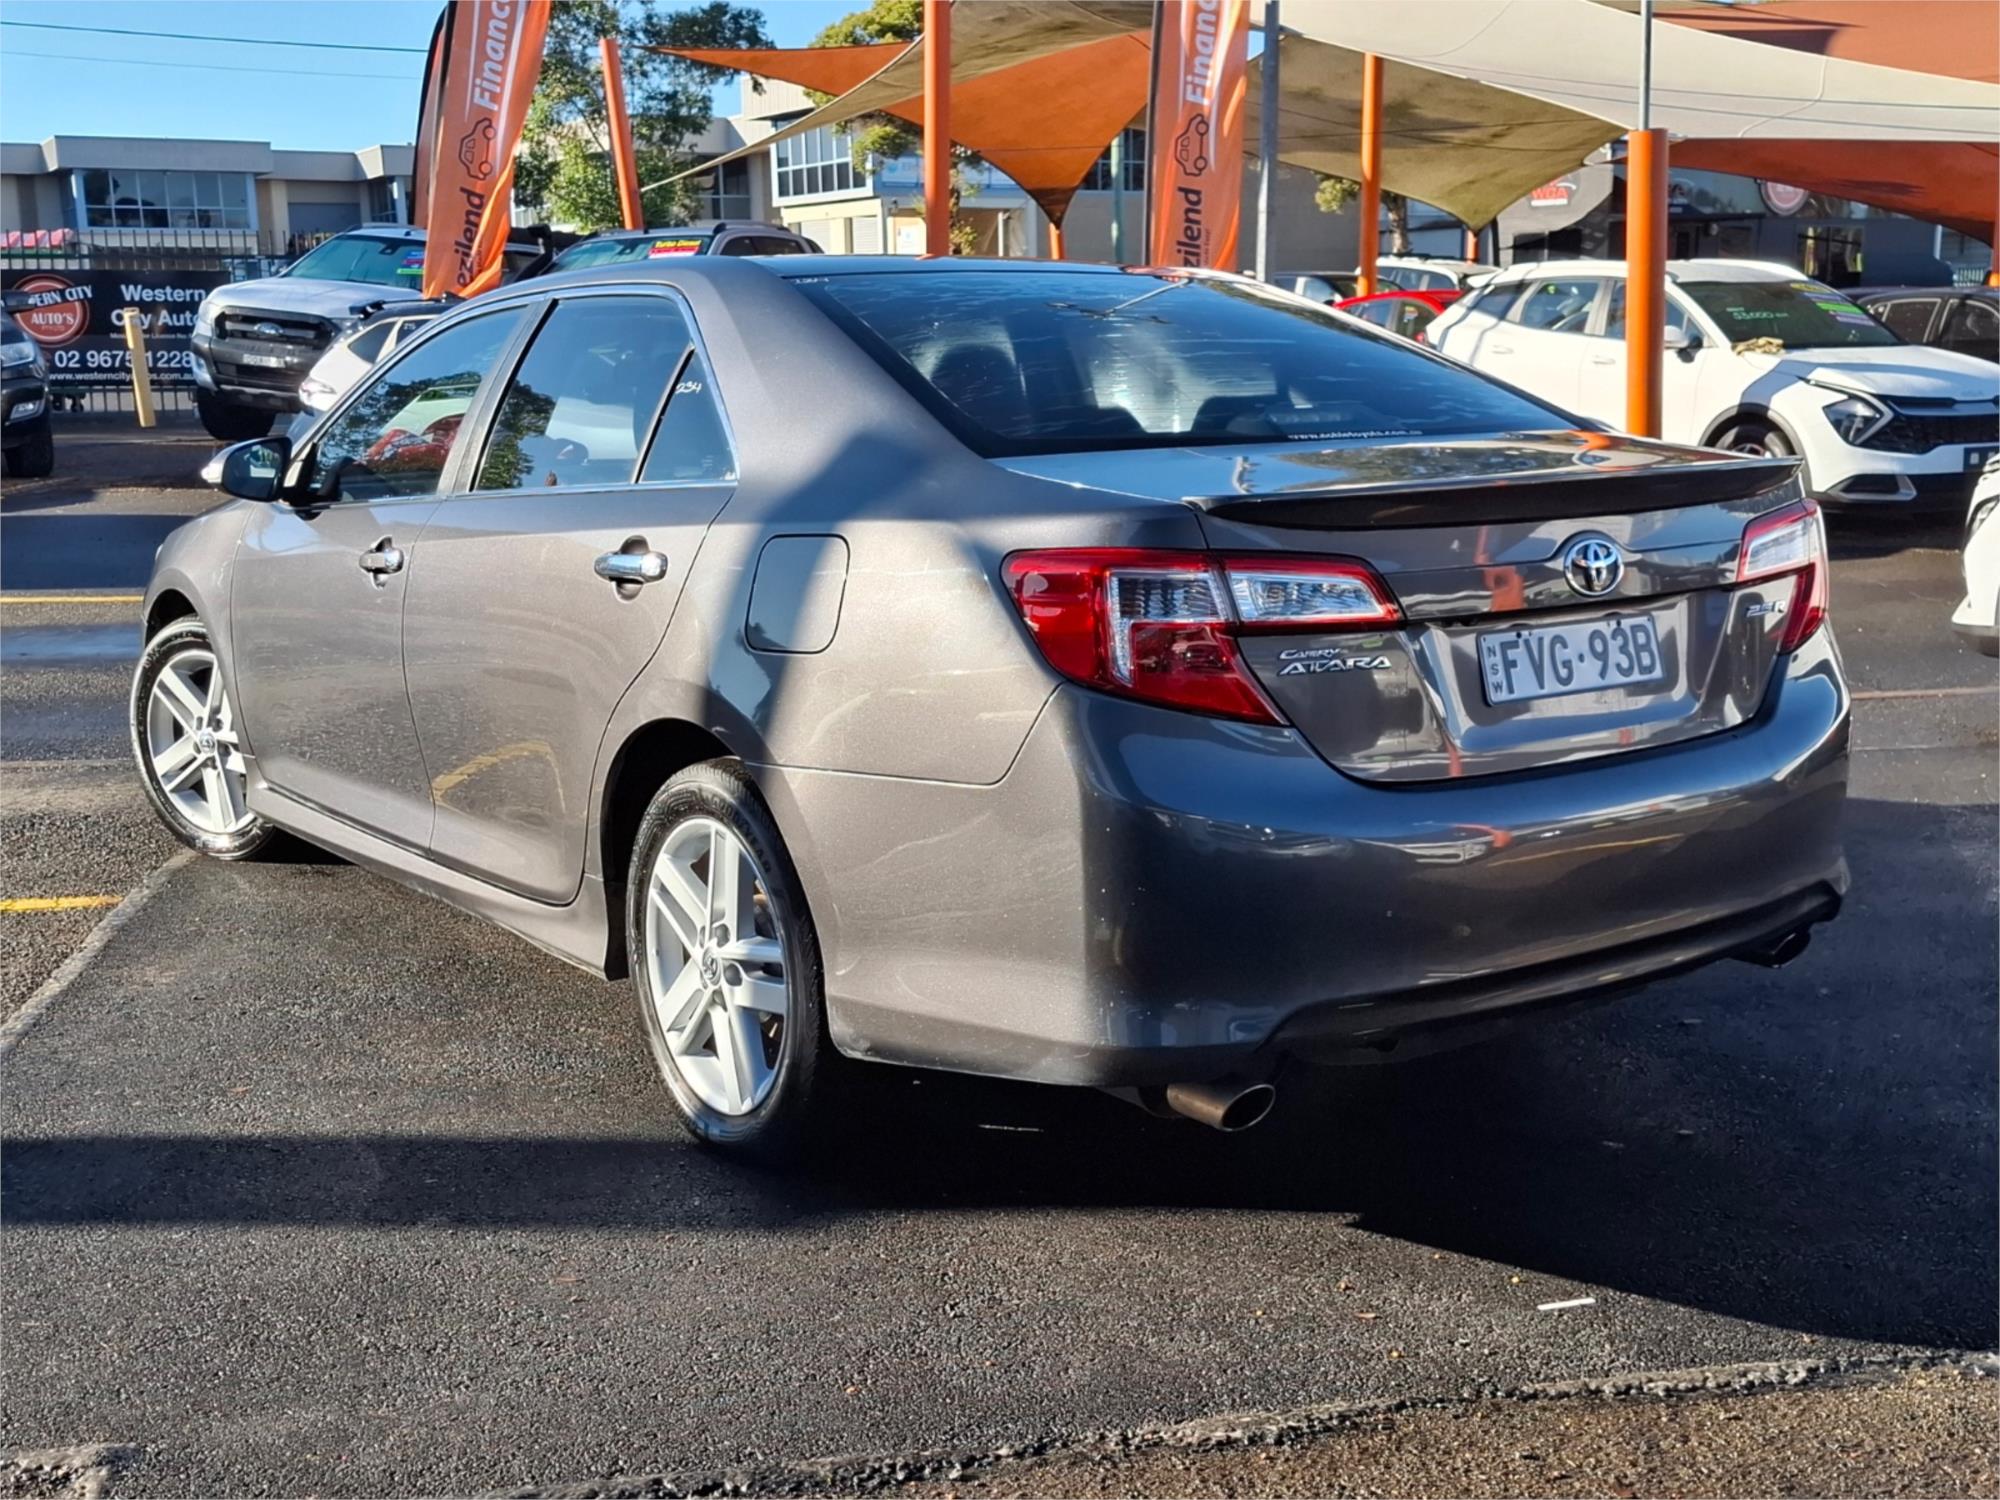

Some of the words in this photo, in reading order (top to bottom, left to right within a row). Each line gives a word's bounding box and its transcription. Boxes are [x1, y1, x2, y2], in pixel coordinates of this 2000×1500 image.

[473, 0, 511, 111] Financ
[1176, 186, 1202, 268] zilend
[120, 284, 206, 302] Western
[54, 350, 81, 368] 02
[144, 350, 193, 368] 1228
[1277, 655, 1393, 676] ATARA
